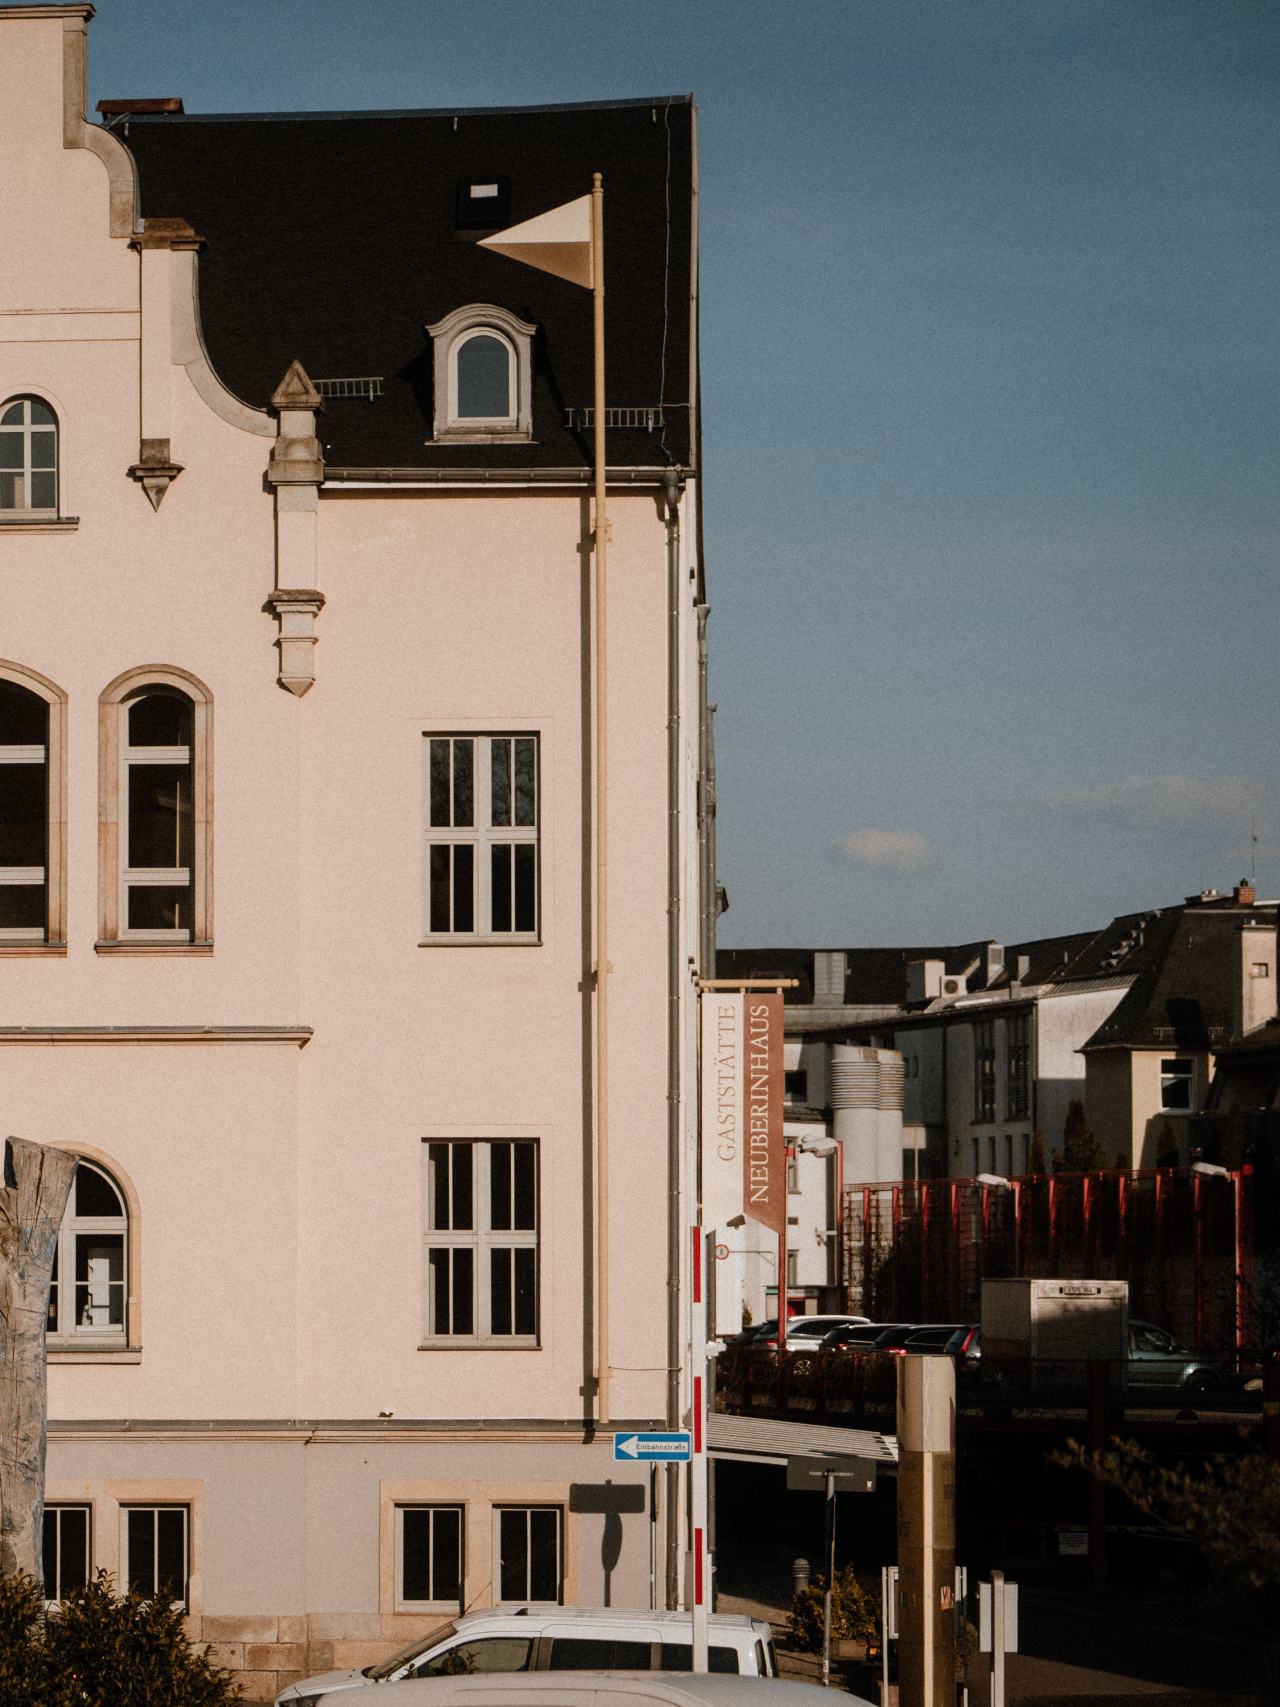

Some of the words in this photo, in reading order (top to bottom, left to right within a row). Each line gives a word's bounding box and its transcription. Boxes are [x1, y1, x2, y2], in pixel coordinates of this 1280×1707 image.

[714, 1006, 736, 1161] GASTSTÄTTE
[750, 1004, 768, 1204] NEUBERINHAUS
[636, 1443, 686, 1451] Einbahnstraße
